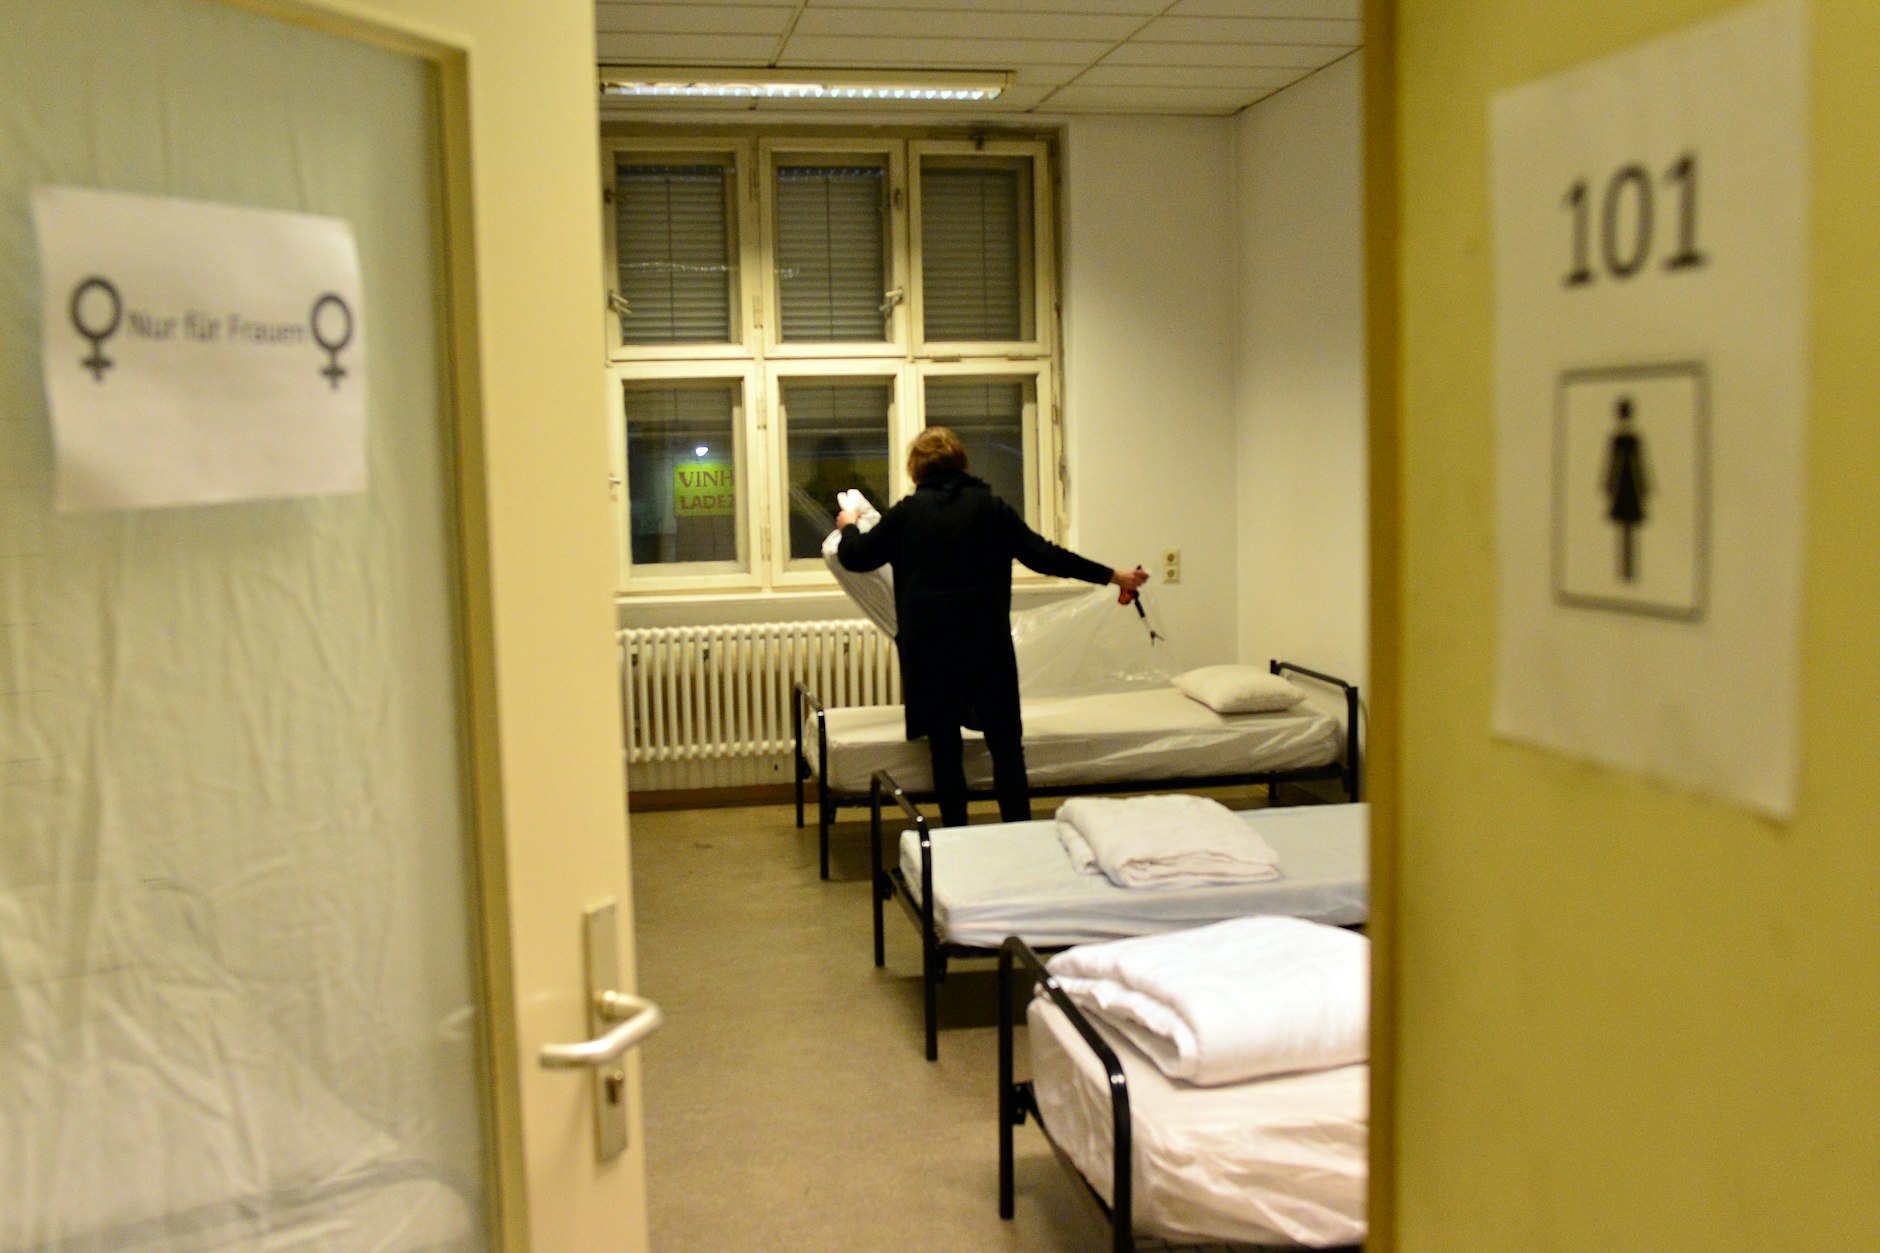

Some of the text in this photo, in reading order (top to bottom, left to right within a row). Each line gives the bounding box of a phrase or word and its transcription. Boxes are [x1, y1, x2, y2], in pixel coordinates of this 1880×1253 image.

[1561, 151, 1708, 288] 101
[128, 309, 305, 343] Nur für Frauen
